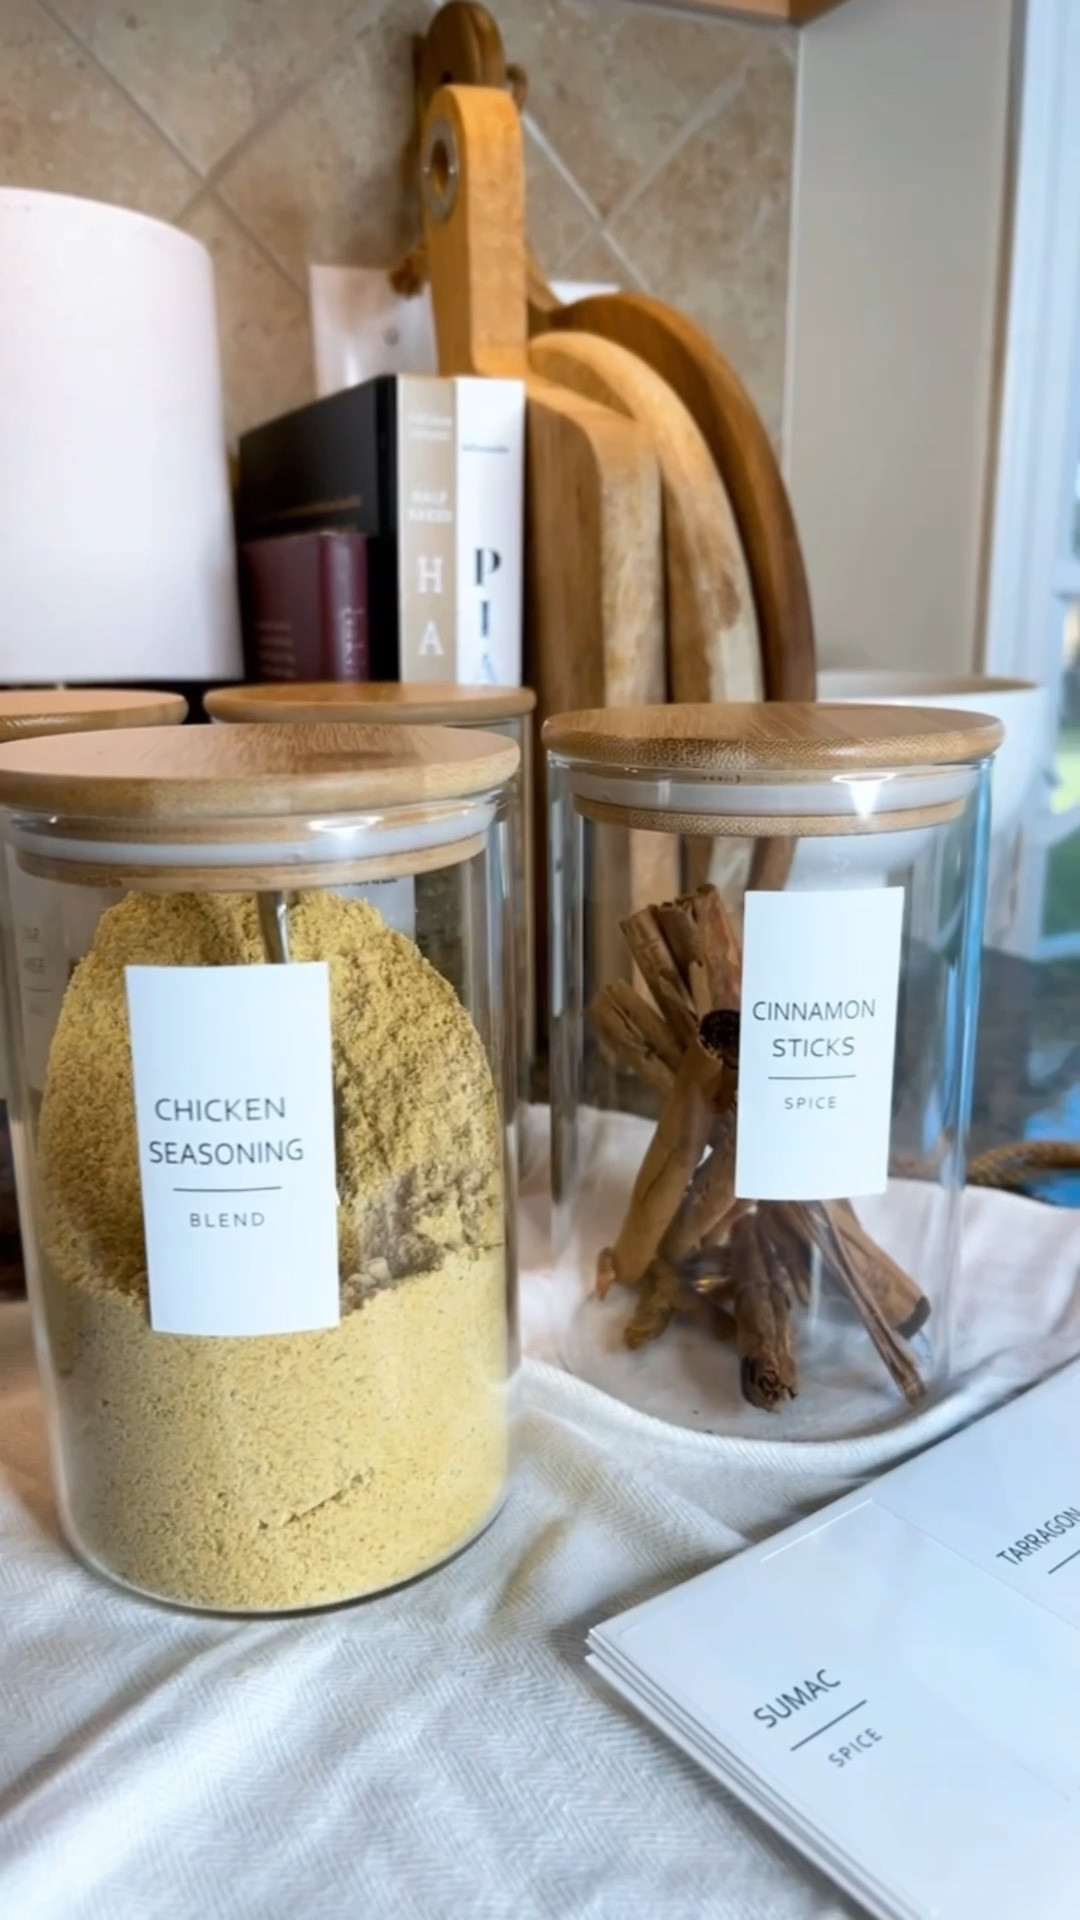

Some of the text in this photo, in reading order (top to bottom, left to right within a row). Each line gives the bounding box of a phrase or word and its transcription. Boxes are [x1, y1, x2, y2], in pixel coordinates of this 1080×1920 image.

[752, 998, 876, 1021] CINNAMON
[772, 1036, 855, 1058] STICKS
[155, 1097, 285, 1122] CHICKEN
[784, 1096, 837, 1110] SPICE
[148, 1138, 304, 1165] SEASONING
[189, 1212, 265, 1228] BLEND
[996, 1507, 1080, 1565] TARRAGON
[753, 1668, 841, 1729] SUMAC
[828, 1728, 883, 1768] SPICE
